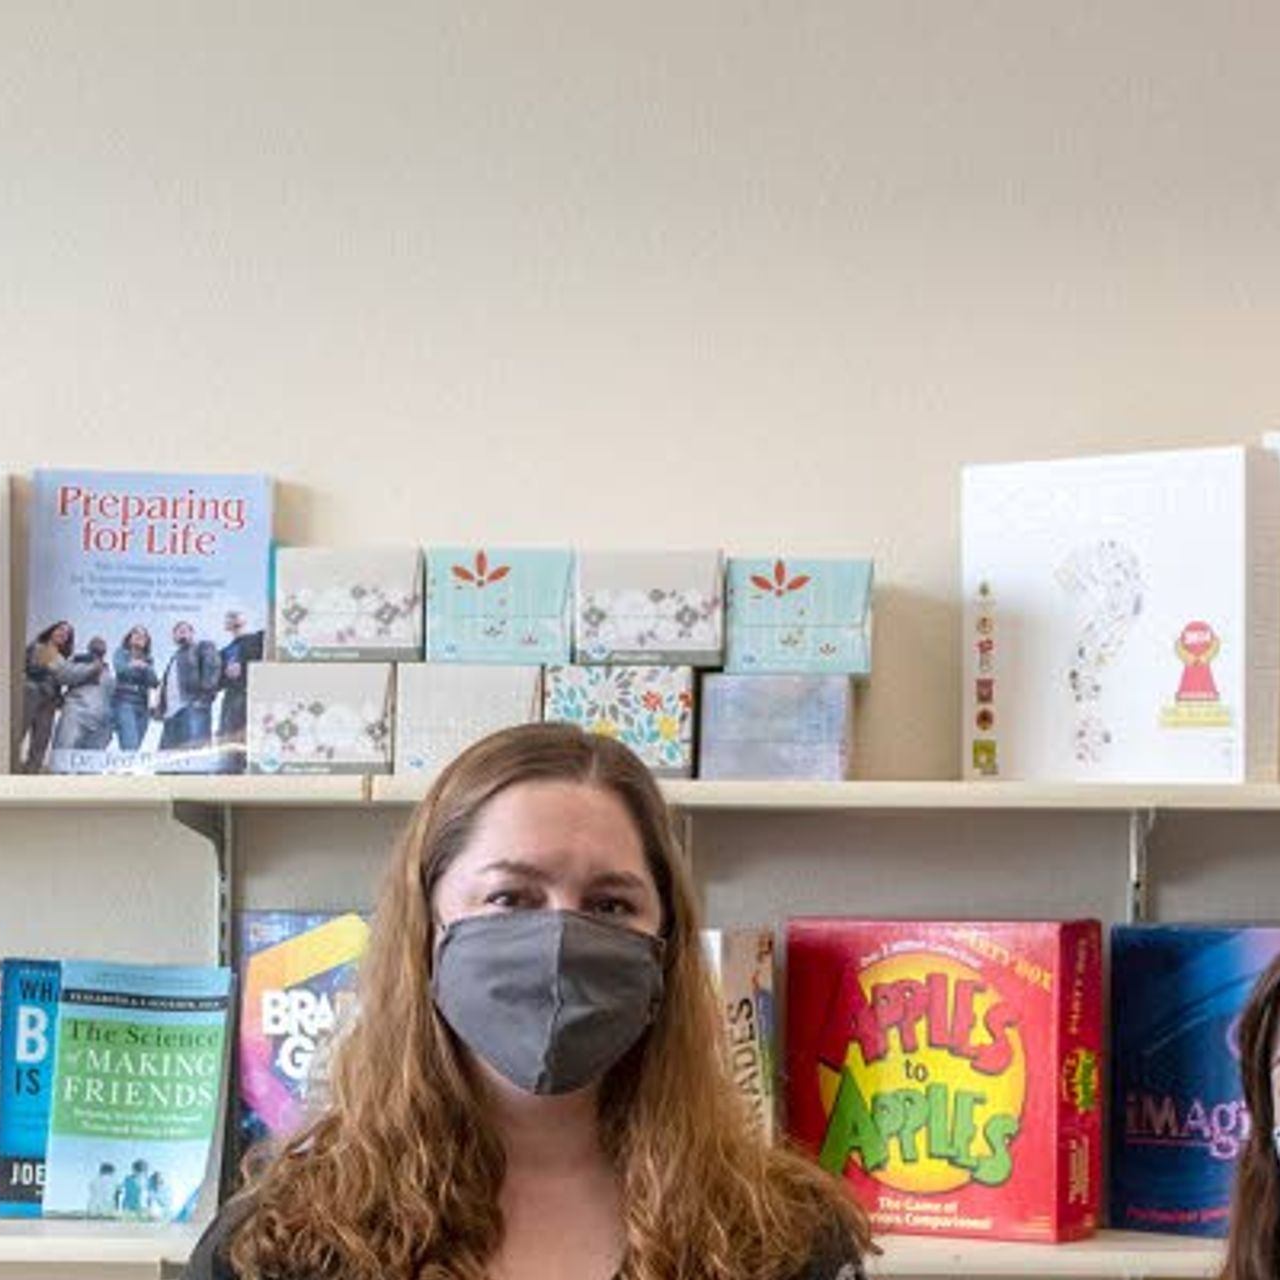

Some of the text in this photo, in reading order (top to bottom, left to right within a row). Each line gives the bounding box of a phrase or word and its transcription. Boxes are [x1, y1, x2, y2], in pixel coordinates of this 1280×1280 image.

[59, 486, 246, 530] Preparing
[83, 519, 217, 555] for Life
[16, 1005, 48, 1062] B
[70, 1019, 219, 1048] The Science
[820, 973, 1020, 1077] APPLES
[86, 1049, 216, 1077] MAKING
[905, 1059, 929, 1082] to
[15, 1069, 40, 1096] IS
[64, 1076, 214, 1108] FRIENDS
[820, 1067, 1021, 1188] APPLES
